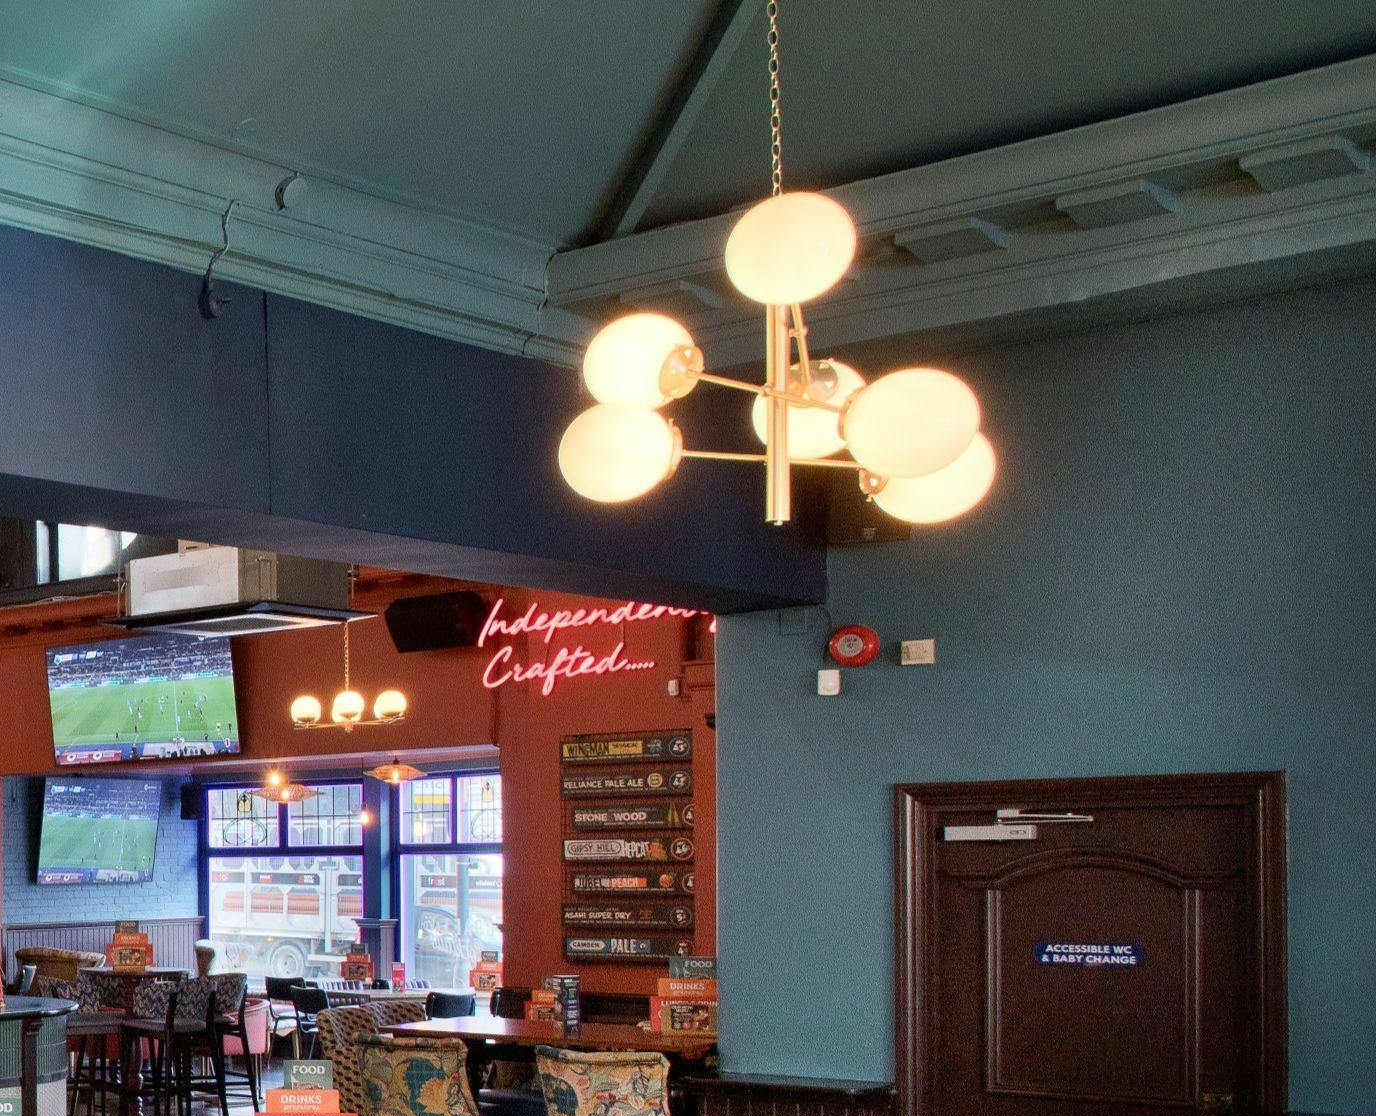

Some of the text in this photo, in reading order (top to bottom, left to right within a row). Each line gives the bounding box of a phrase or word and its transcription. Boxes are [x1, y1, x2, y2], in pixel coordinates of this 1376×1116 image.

[477, 598, 717, 648] Independen
[564, 778, 645, 789] RELIANCE PALE ALE
[574, 813, 608, 822] STONE
[613, 812, 647, 821] WOOD
[570, 841, 649, 858] GIPSY HILL HEPCAT
[578, 878, 601, 887] JUBEL
[612, 878, 638, 888] PEACH
[564, 911, 586, 919] ASAHI
[614, 912, 631, 920] DRY
[610, 939, 637, 953] PALE
[1046, 944, 1132, 954] ACCESSIBLE WC
[1041, 954, 1136, 964] & BABY CHANGE
[293, 1066, 325, 1074] FOOD
[280, 1095, 322, 1104] DRINKS
